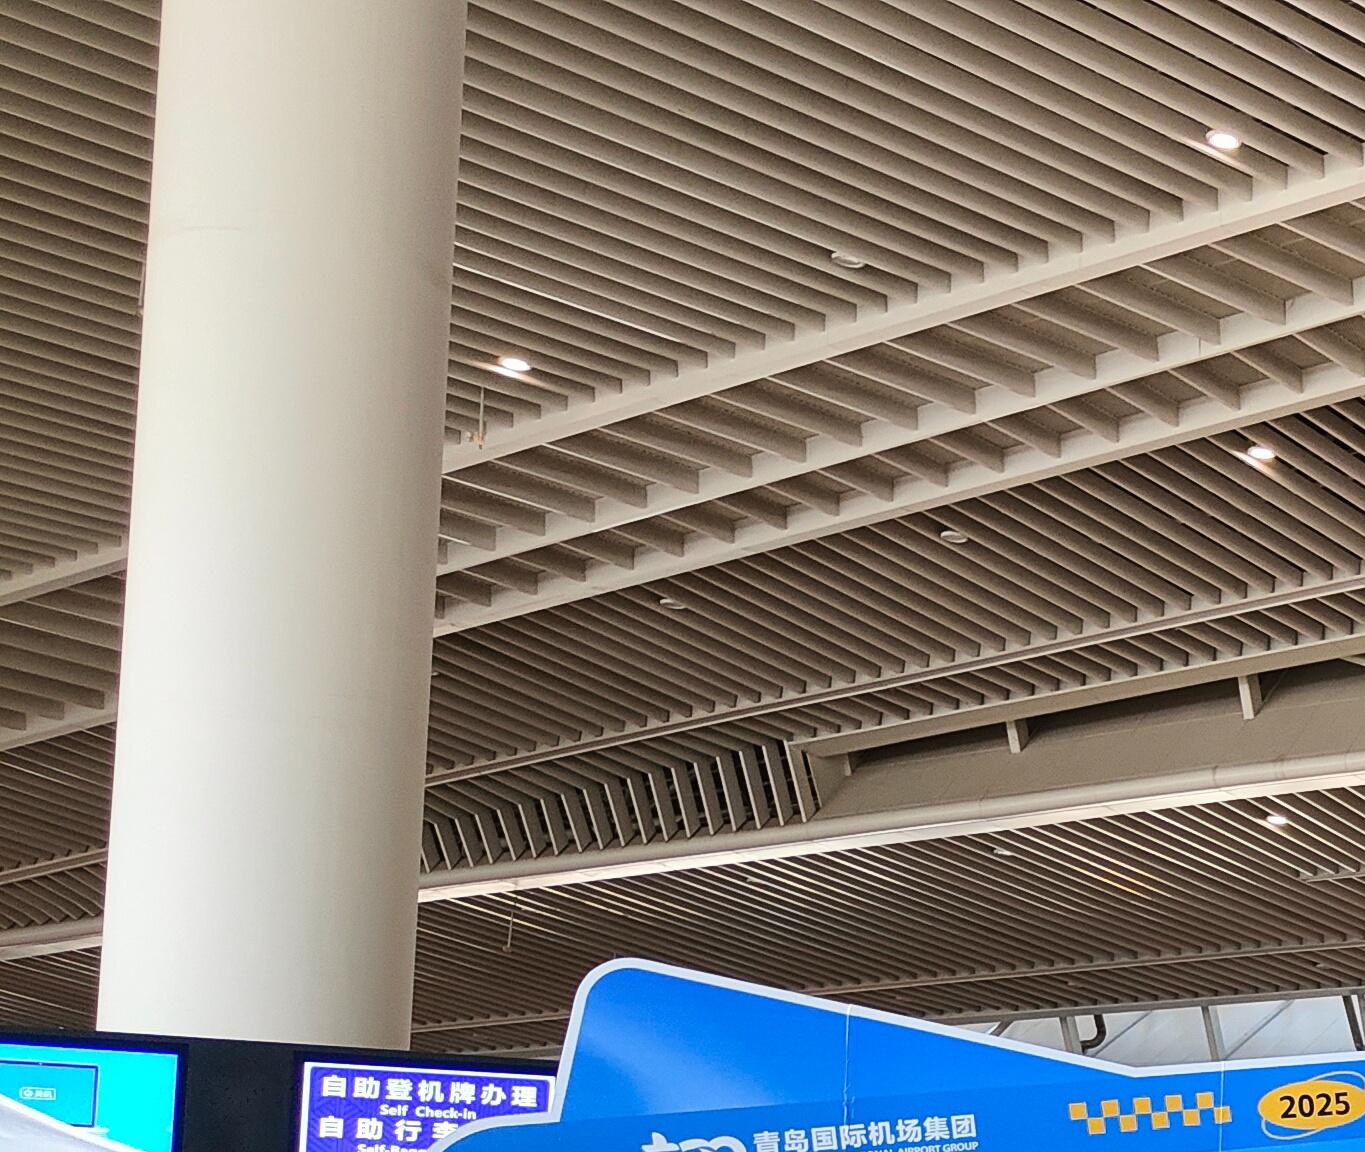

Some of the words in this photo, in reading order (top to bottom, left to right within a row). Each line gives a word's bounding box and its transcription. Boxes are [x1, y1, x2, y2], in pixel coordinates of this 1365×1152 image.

[321, 1074, 538, 1108] 自助登机牌办理
[379, 1104, 409, 1117] Self
[415, 1106, 477, 1120] Check-in
[1279, 1091, 1351, 1119] 2025
[942, 1141, 979, 1152] GROUP
